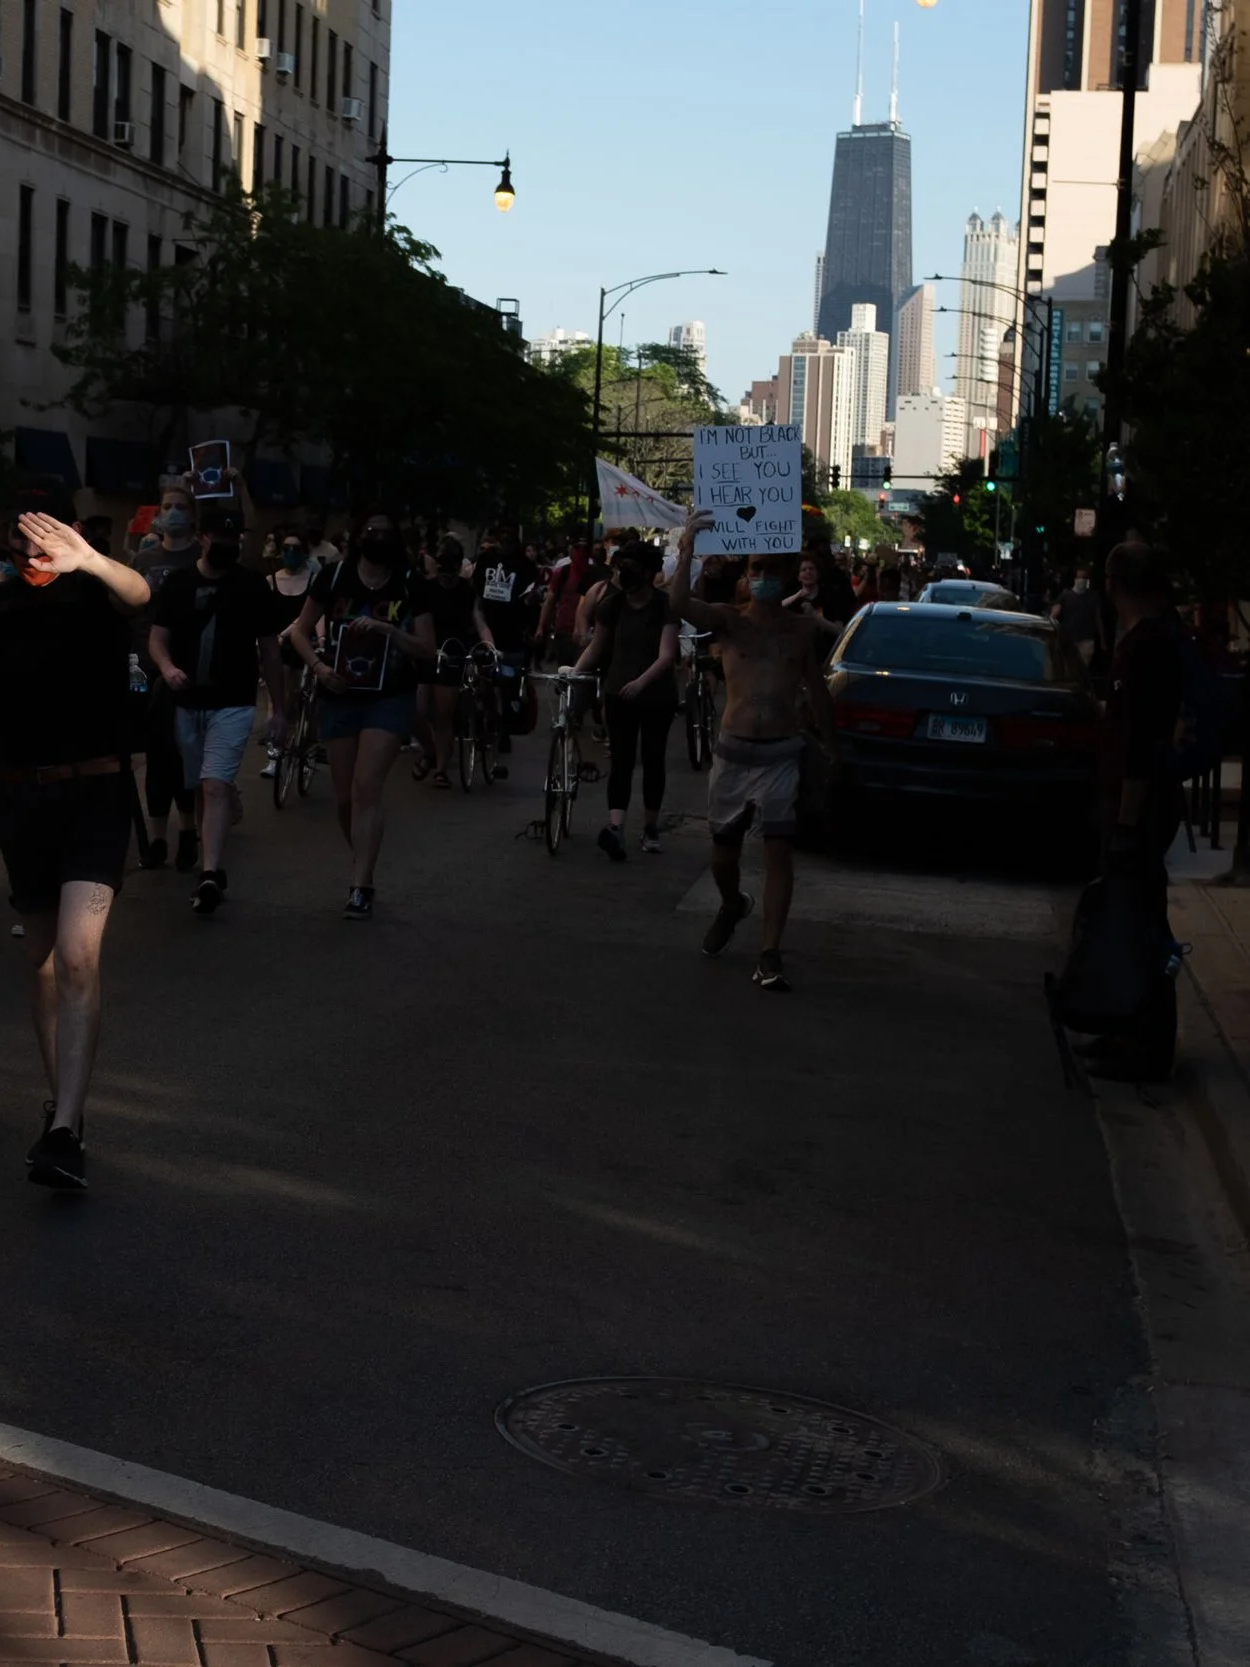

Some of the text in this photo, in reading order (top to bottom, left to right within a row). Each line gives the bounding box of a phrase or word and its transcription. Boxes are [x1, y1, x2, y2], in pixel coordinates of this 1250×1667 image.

[700, 426, 801, 445] I'M NOT BLACK
[711, 462, 742, 480] SEE
[754, 461, 791, 479] YOU
[710, 484, 752, 504] HEAR
[759, 486, 793, 505] YOU
[755, 520, 797, 532] FIGHT
[721, 537, 794, 551] WITH YOU
